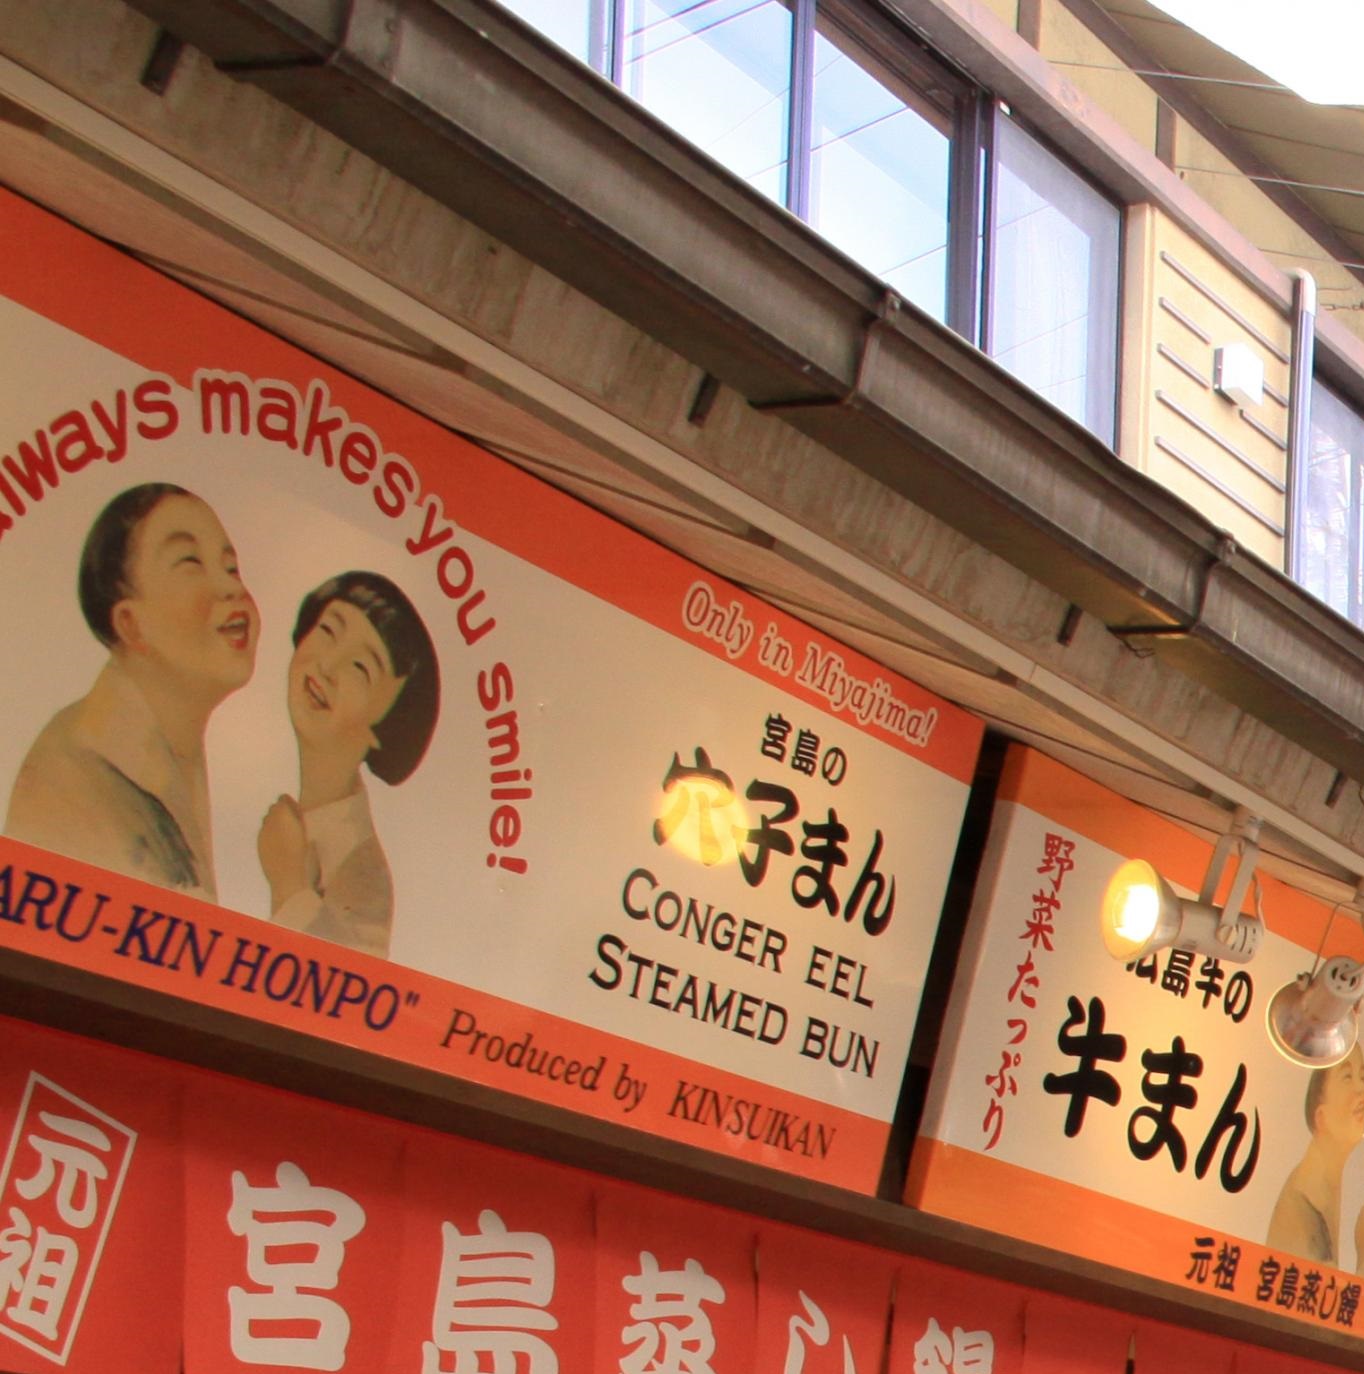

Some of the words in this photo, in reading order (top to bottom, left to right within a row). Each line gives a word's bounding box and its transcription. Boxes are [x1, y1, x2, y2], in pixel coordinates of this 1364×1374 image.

[200, 374, 421, 519] makes
[406, 503, 496, 646] you
[477, 663, 533, 876] smile!
[685, 582, 752, 656] Only
[762, 624, 793, 673] in
[799, 646, 934, 750] Miyajima!
[763, 713, 848, 787] 宮島の
[652, 746, 895, 937] 穴子まん
[589, 932, 788, 1049] STEAMED
[801, 1018, 881, 1080] BUN
[622, 868, 789, 972] CONGER
[803, 942, 875, 1009] EEL
[981, 833, 1076, 1153] 野菜たっぷり
[439, 1009, 605, 1094] Produced
[614, 1063, 647, 1113] by
[666, 1080, 838, 1163] KINSUIKAN
[1042, 995, 1263, 1195] 牛まん
[0, 1110, 112, 1344] 元祖
[1184, 1236, 1240, 1293] 元祖
[1255, 1256, 1364, 1328] 宮島蒸し饅
